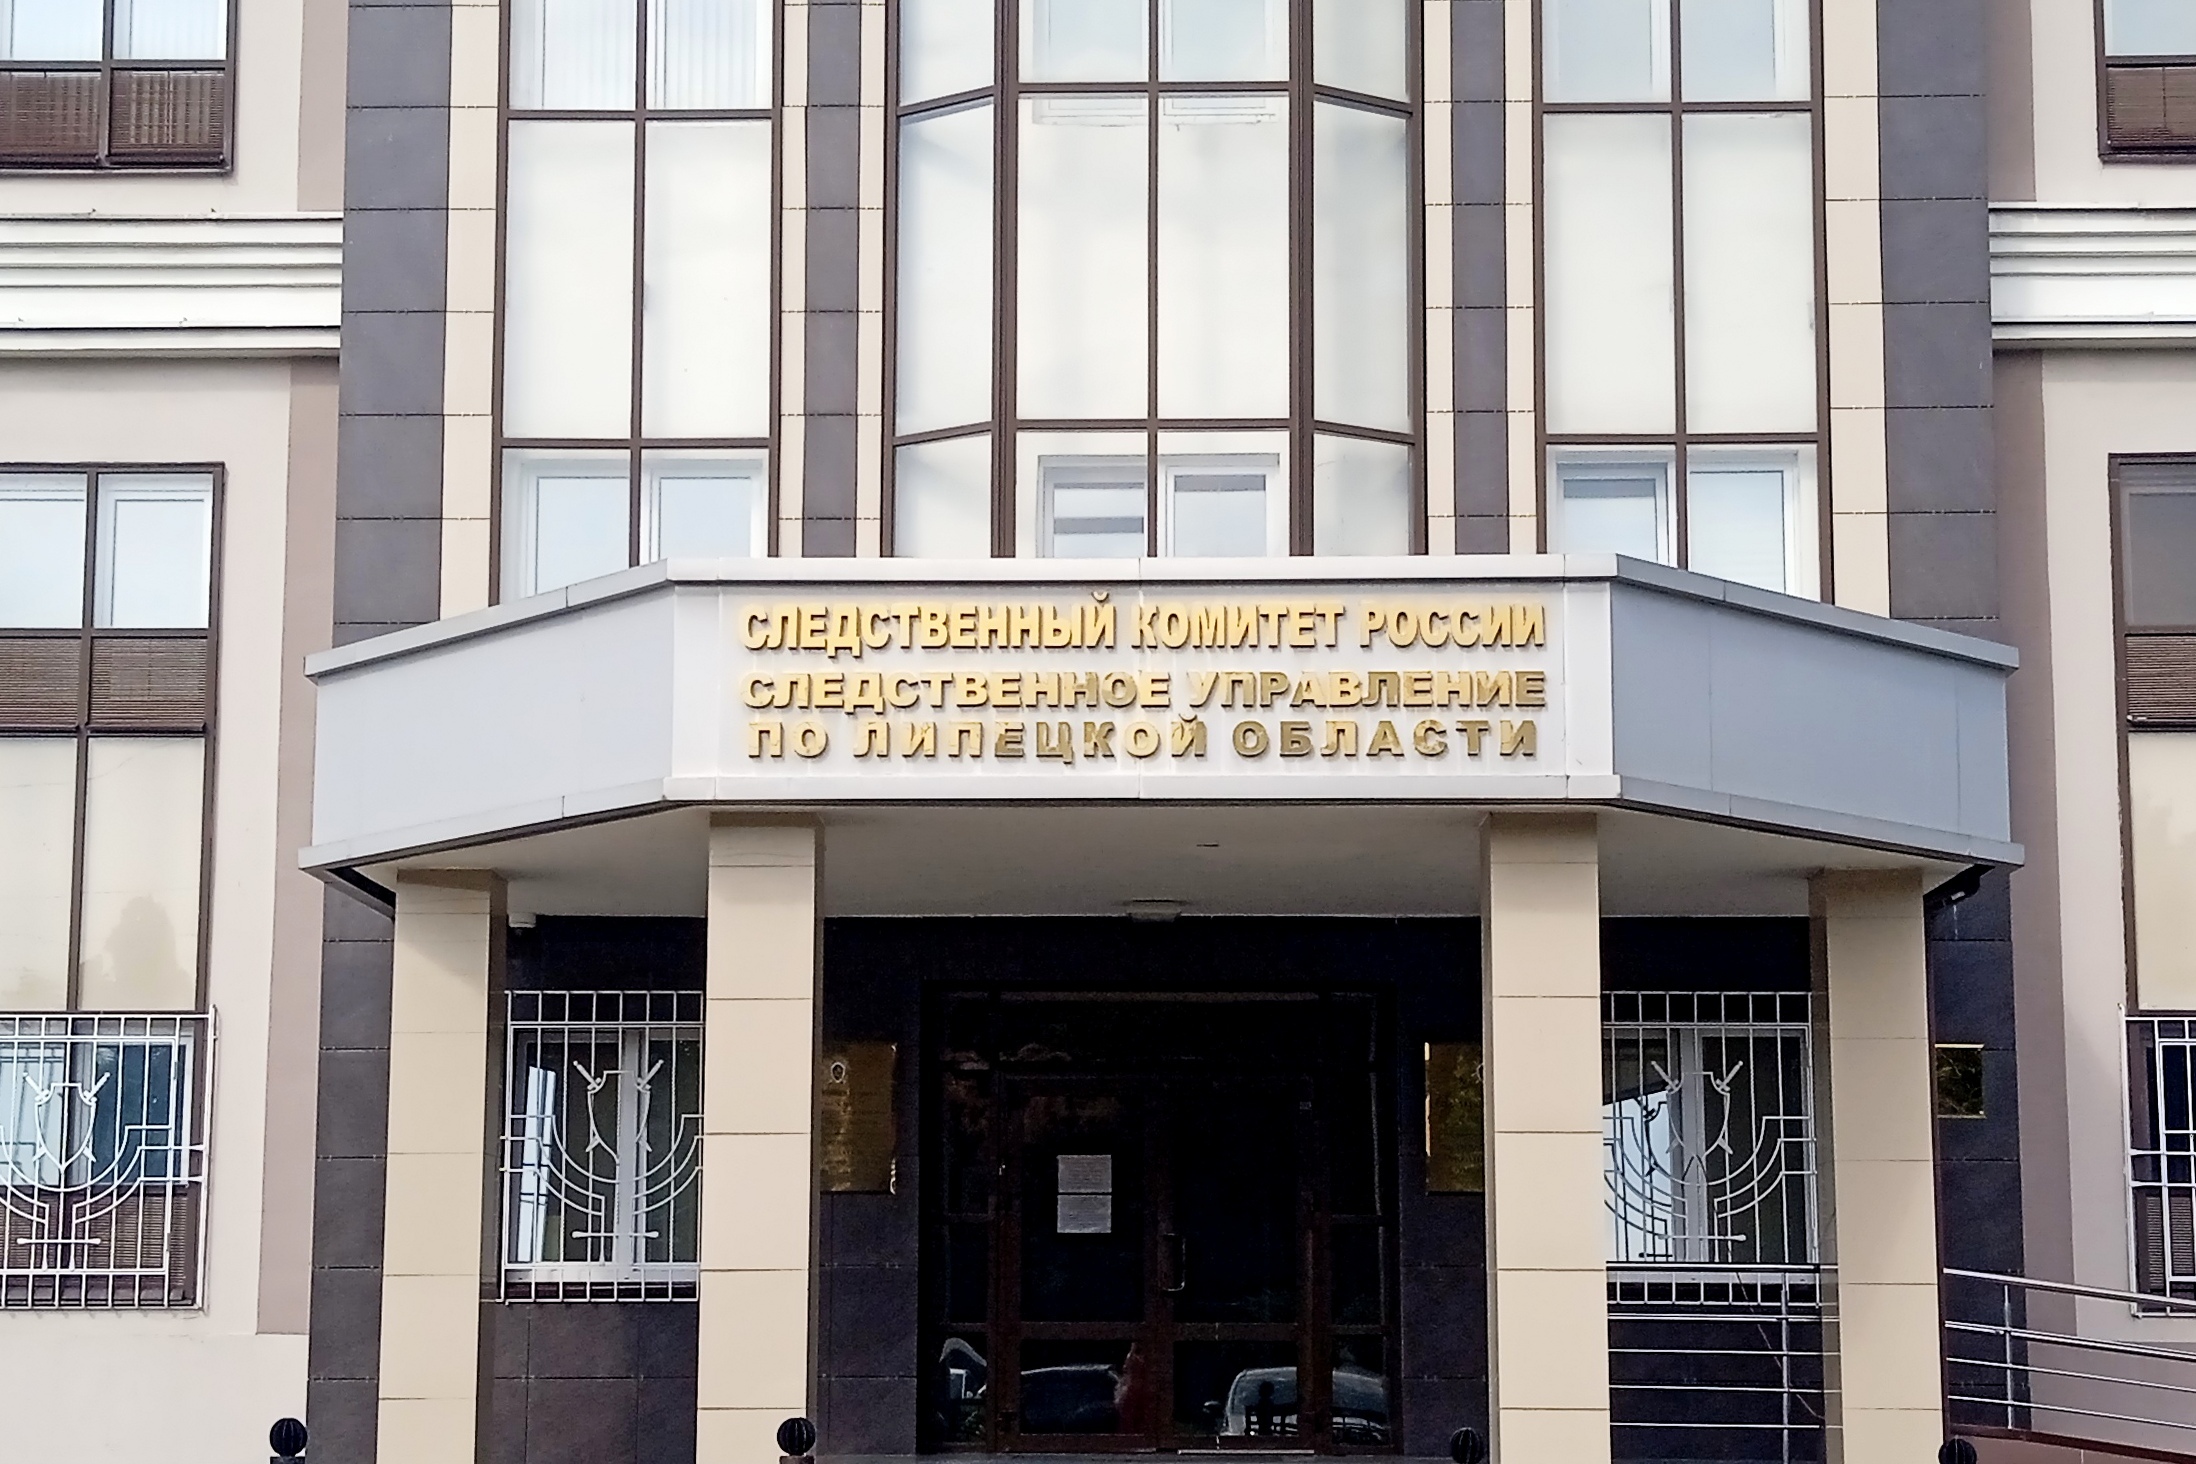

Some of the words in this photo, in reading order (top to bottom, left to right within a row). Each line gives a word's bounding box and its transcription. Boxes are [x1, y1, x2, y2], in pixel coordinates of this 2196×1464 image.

[740, 591, 1117, 658] СЛЕДСТВЕННЫЙ
[1131, 602, 1346, 649] КОМИТЕТ
[1360, 601, 1546, 648] РОССИИ
[741, 671, 1170, 714] СЛЕДСТВЕННОЕ
[1188, 670, 1546, 707] УПРАВЛЕНИЕ
[748, 721, 829, 759] ПО
[853, 714, 1208, 764] ЛИПЕЦКОЙ
[1232, 719, 1537, 758] ОБЛАСТИ
